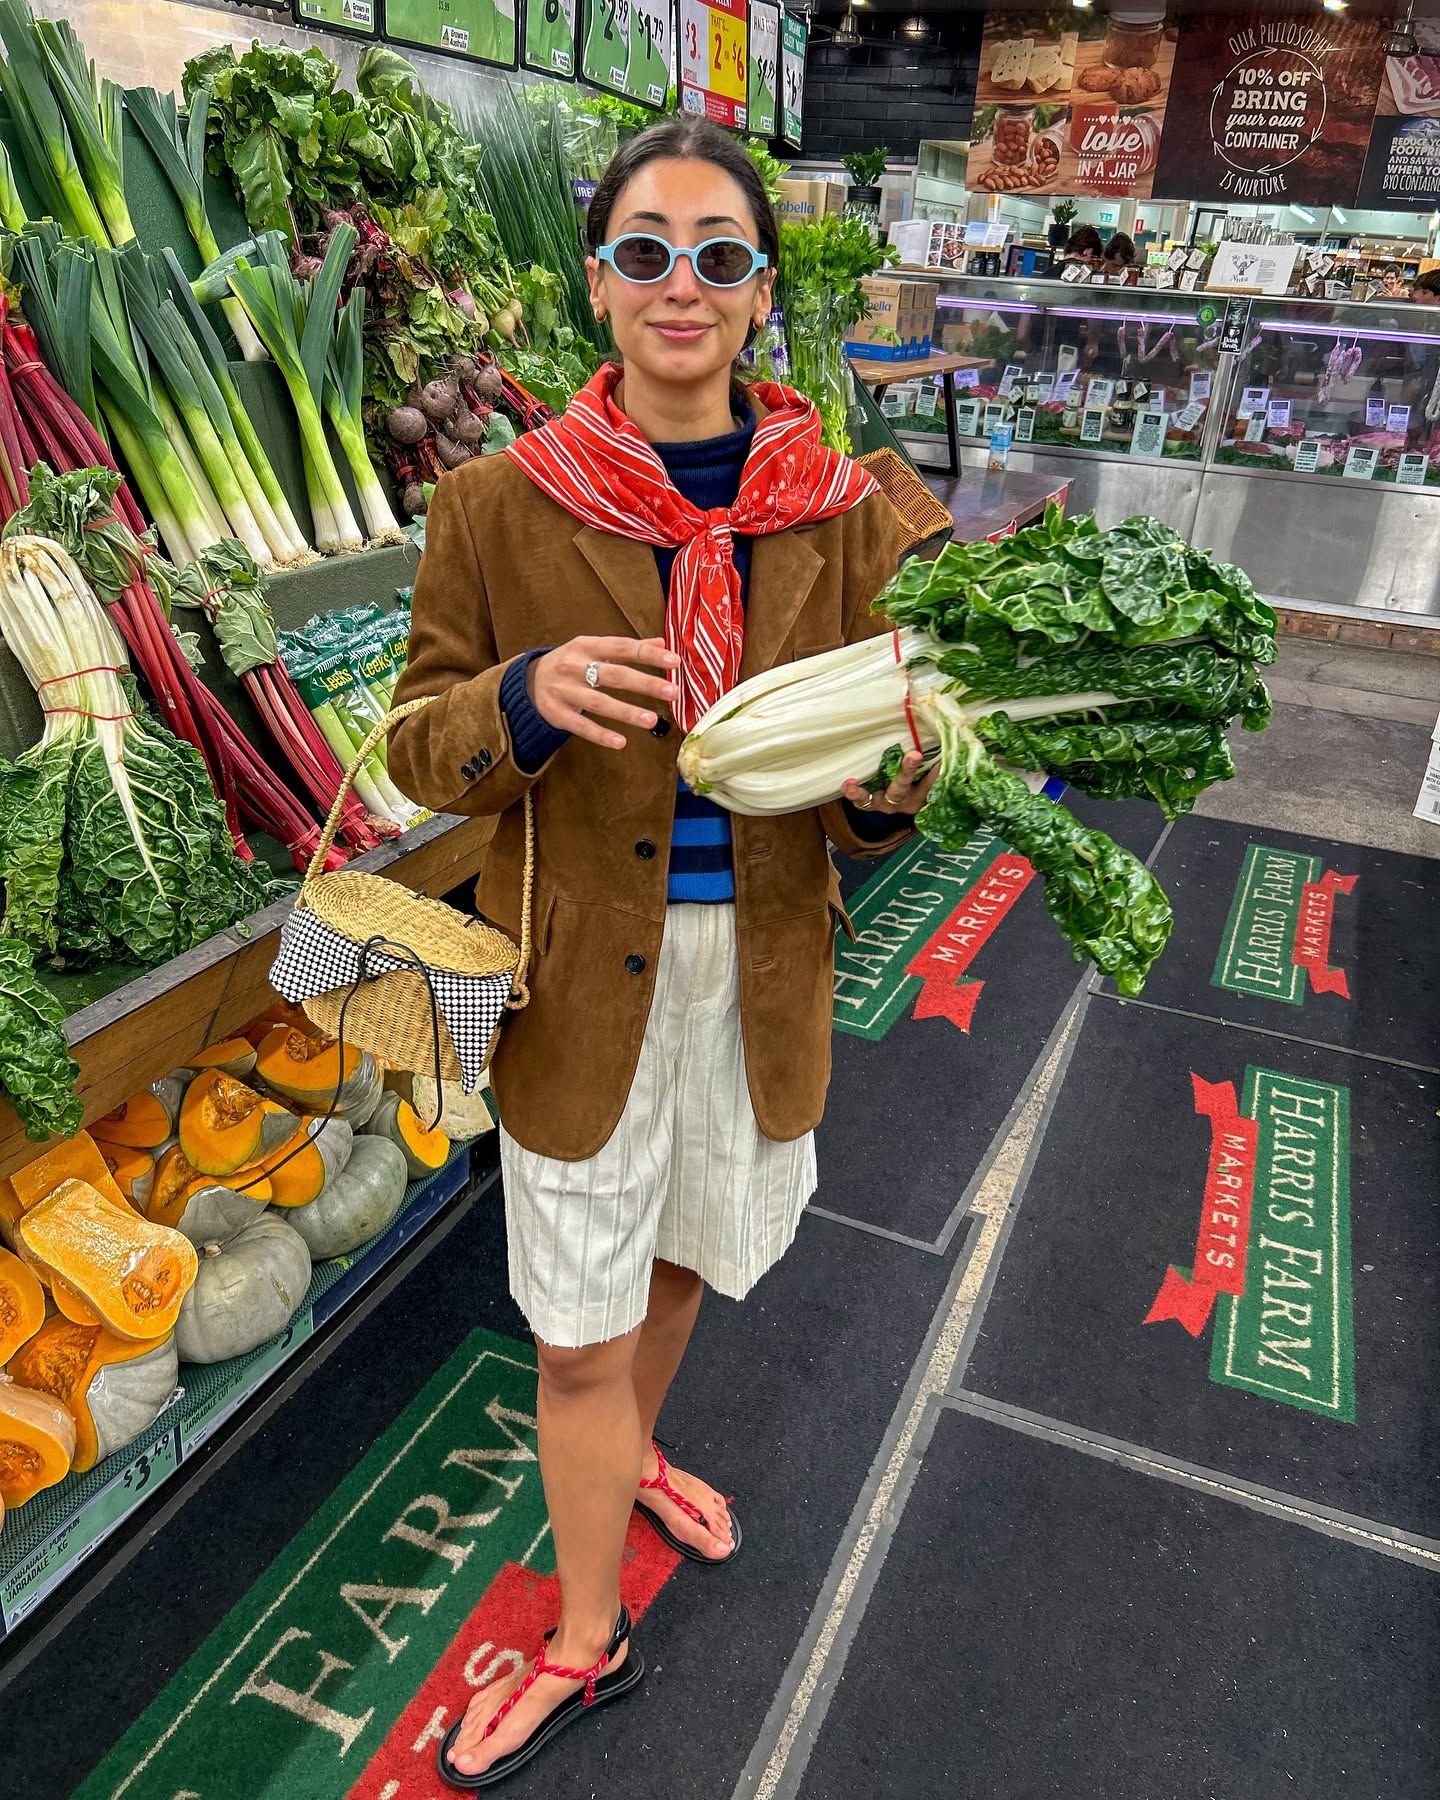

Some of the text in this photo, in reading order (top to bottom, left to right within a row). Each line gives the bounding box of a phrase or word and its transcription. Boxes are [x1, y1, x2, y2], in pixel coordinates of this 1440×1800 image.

[638, 7, 664, 60] $1.79
[1229, 22, 1333, 60] OUR PHILOSOPHY
[1238, 68, 1311, 86] 10% OFF
[1231, 89, 1308, 111] BRING
[1225, 113, 1305, 130] your own
[1081, 125, 1142, 152] love
[1224, 131, 1299, 150] CONTAINER
[1390, 145, 1440, 156] FOOTPRI
[1392, 137, 1428, 146] REDUCE
[1094, 160, 1105, 178] A
[1108, 161, 1138, 179] JAR
[1387, 164, 1422, 175] WHEN
[1388, 156, 1433, 165] AND SAVE
[1219, 169, 1288, 197] IS NURTURE
[1382, 174, 1399, 190] BYO
[360, 653, 392, 679] Leeks
[320, 667, 354, 693] Leeks
[930, 866, 1025, 964] MARKETS
[1234, 855, 1297, 989] HARRIS FARM
[1301, 891, 1329, 958] MARKETS
[834, 886, 945, 1010] HARRIS
[1205, 1132, 1249, 1270] MARKETS
[1256, 1086, 1326, 1381] HARRIS FARM
[184, 1396, 218, 1434] JARRADALE
[123, 1433, 170, 1492] $3.49
[6, 1559, 50, 1604] JARRADALE
[57, 1540, 69, 1555] KG
[230, 1397, 539, 1758] FARM
